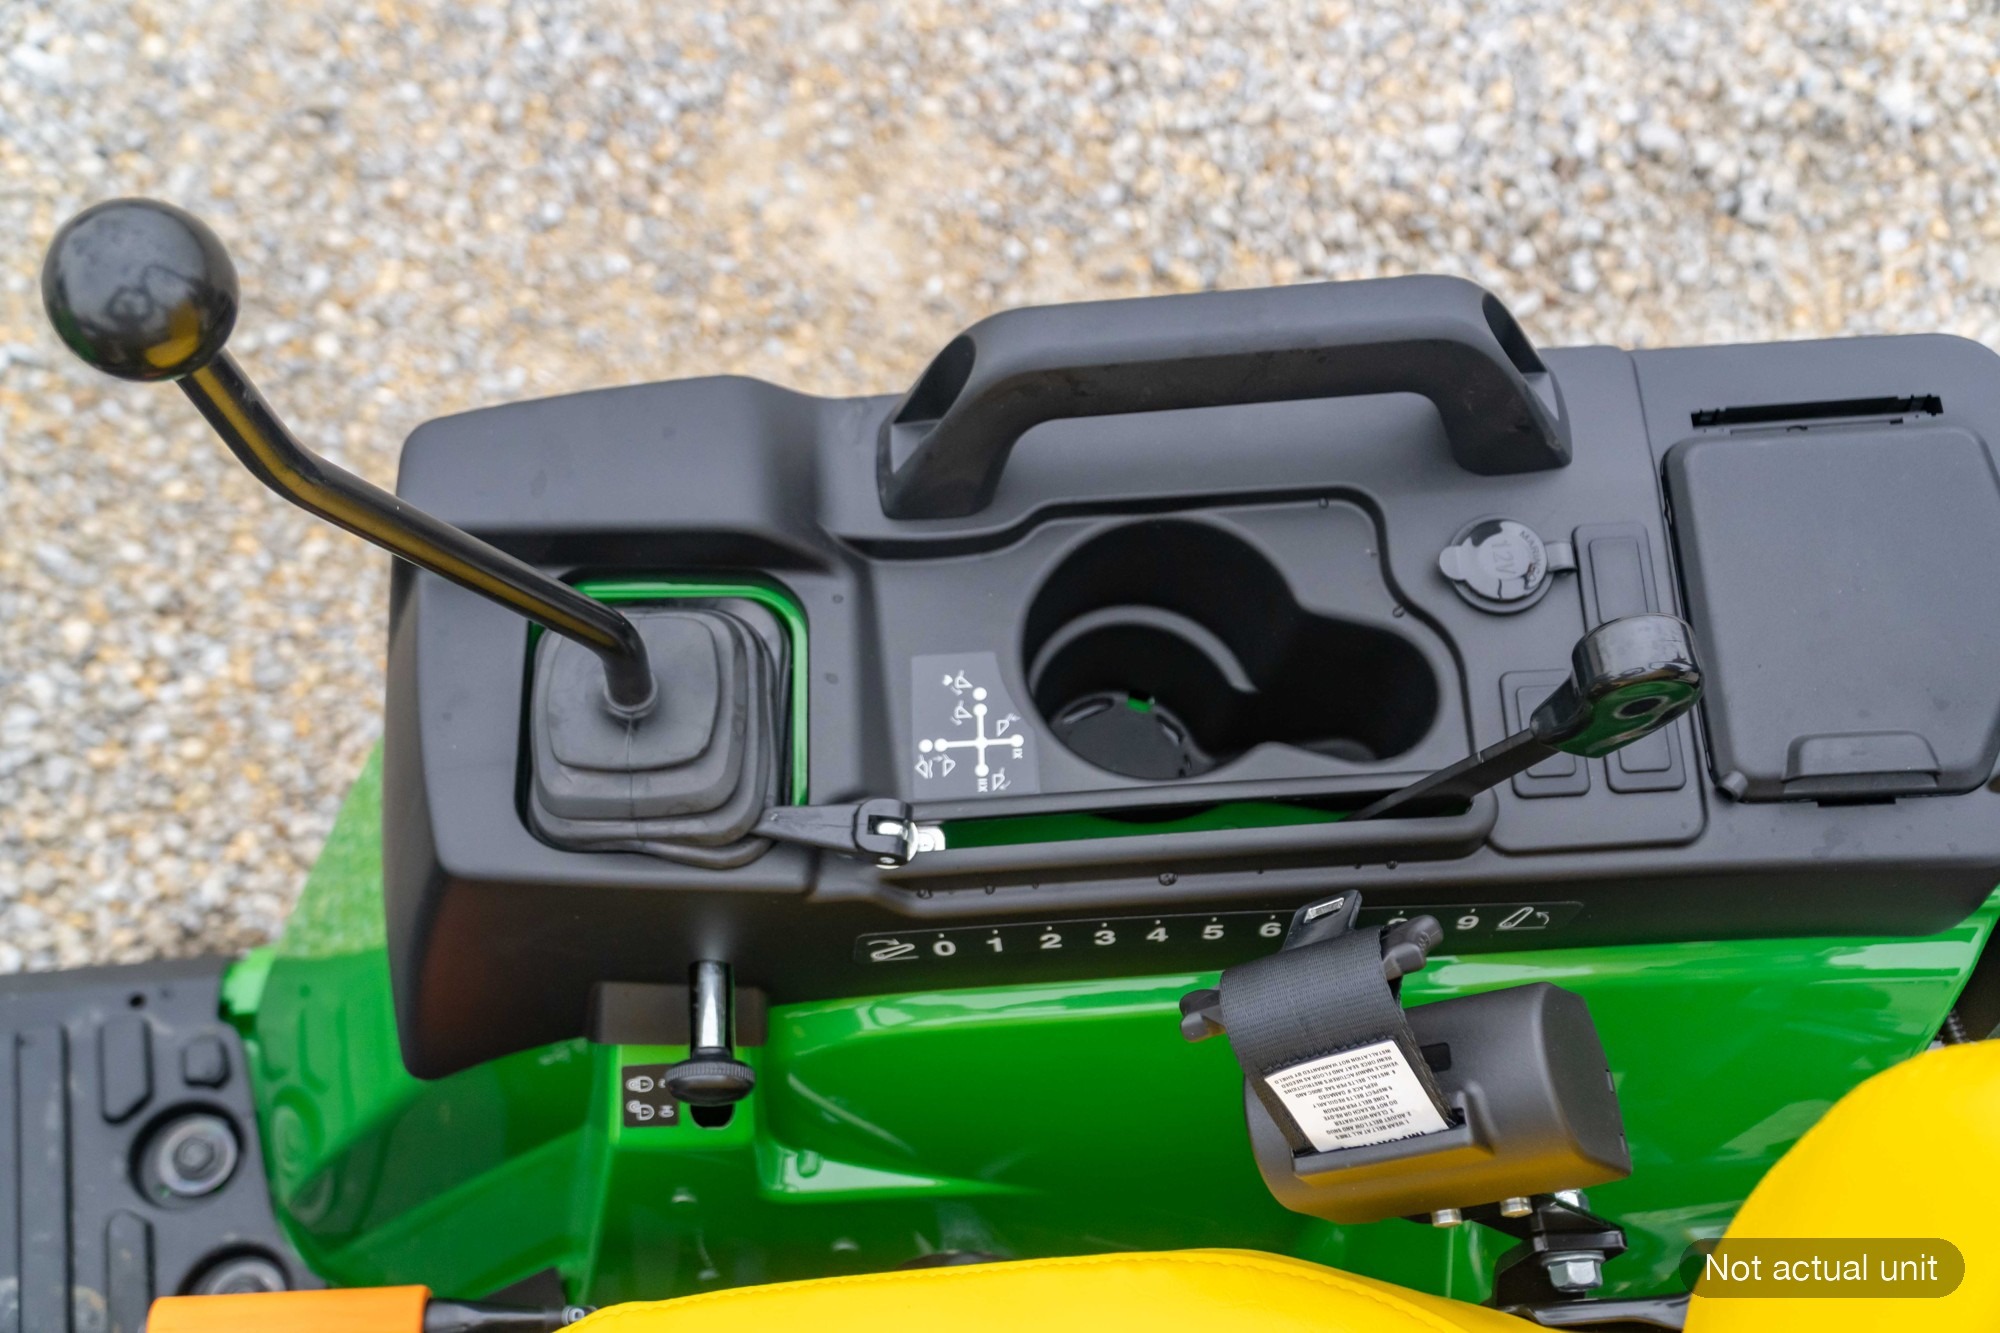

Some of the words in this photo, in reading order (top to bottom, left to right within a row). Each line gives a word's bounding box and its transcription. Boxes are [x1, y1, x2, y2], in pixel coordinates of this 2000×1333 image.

[1491, 540, 1516, 575] 12V
[933, 940, 956, 956] 0
[986, 937, 1003, 952] 1
[1040, 933, 1063, 949] 2
[1094, 930, 1116, 945] 3
[1146, 927, 1169, 942] 4
[1202, 924, 1224, 940] 5
[1259, 922, 1281, 937] 6
[1456, 915, 1480, 930] 9
[1350, 1047, 1391, 1063] INSTALLATION
[1359, 1055, 1392, 1067] REINFORCE
[1374, 1060, 1398, 1071] VEHICLE
[1301, 1061, 1338, 1076] WARRANTED
[1331, 1067, 1344, 1075] AND
[1344, 1063, 1360, 1071] SEAT
[1311, 1071, 1332, 1080] FLOOR
[1366, 1071, 1390, 1080] INSTALL
[1280, 1078, 1304, 1088] NEEDED
[1346, 1077, 1366, 1086] BELTS
[1282, 1079, 1324, 1094] INSTRUCTIONS
[1351, 1081, 1379, 1092] REPLACE
[1363, 1086, 1389, 1096] INSPECT
[1317, 1089, 1346, 1100] DAMAGED
[1345, 1093, 1365, 1101] BELTS
[1356, 1098, 1373, 1106] BELT
[1322, 1105, 1346, 1114] PERSON
[1351, 1105, 1376, 1114] BLEACH
[1368, 1109, 1389, 1118] CLEAN
[1332, 1117, 1355, 1126] WATER
[1367, 1118, 1384, 1126] BELT
[1382, 1113, 1407, 1122] ADJUST
[1385, 1120, 1405, 1129] WEAR
[1325, 1127, 1342, 1135] SNUG
